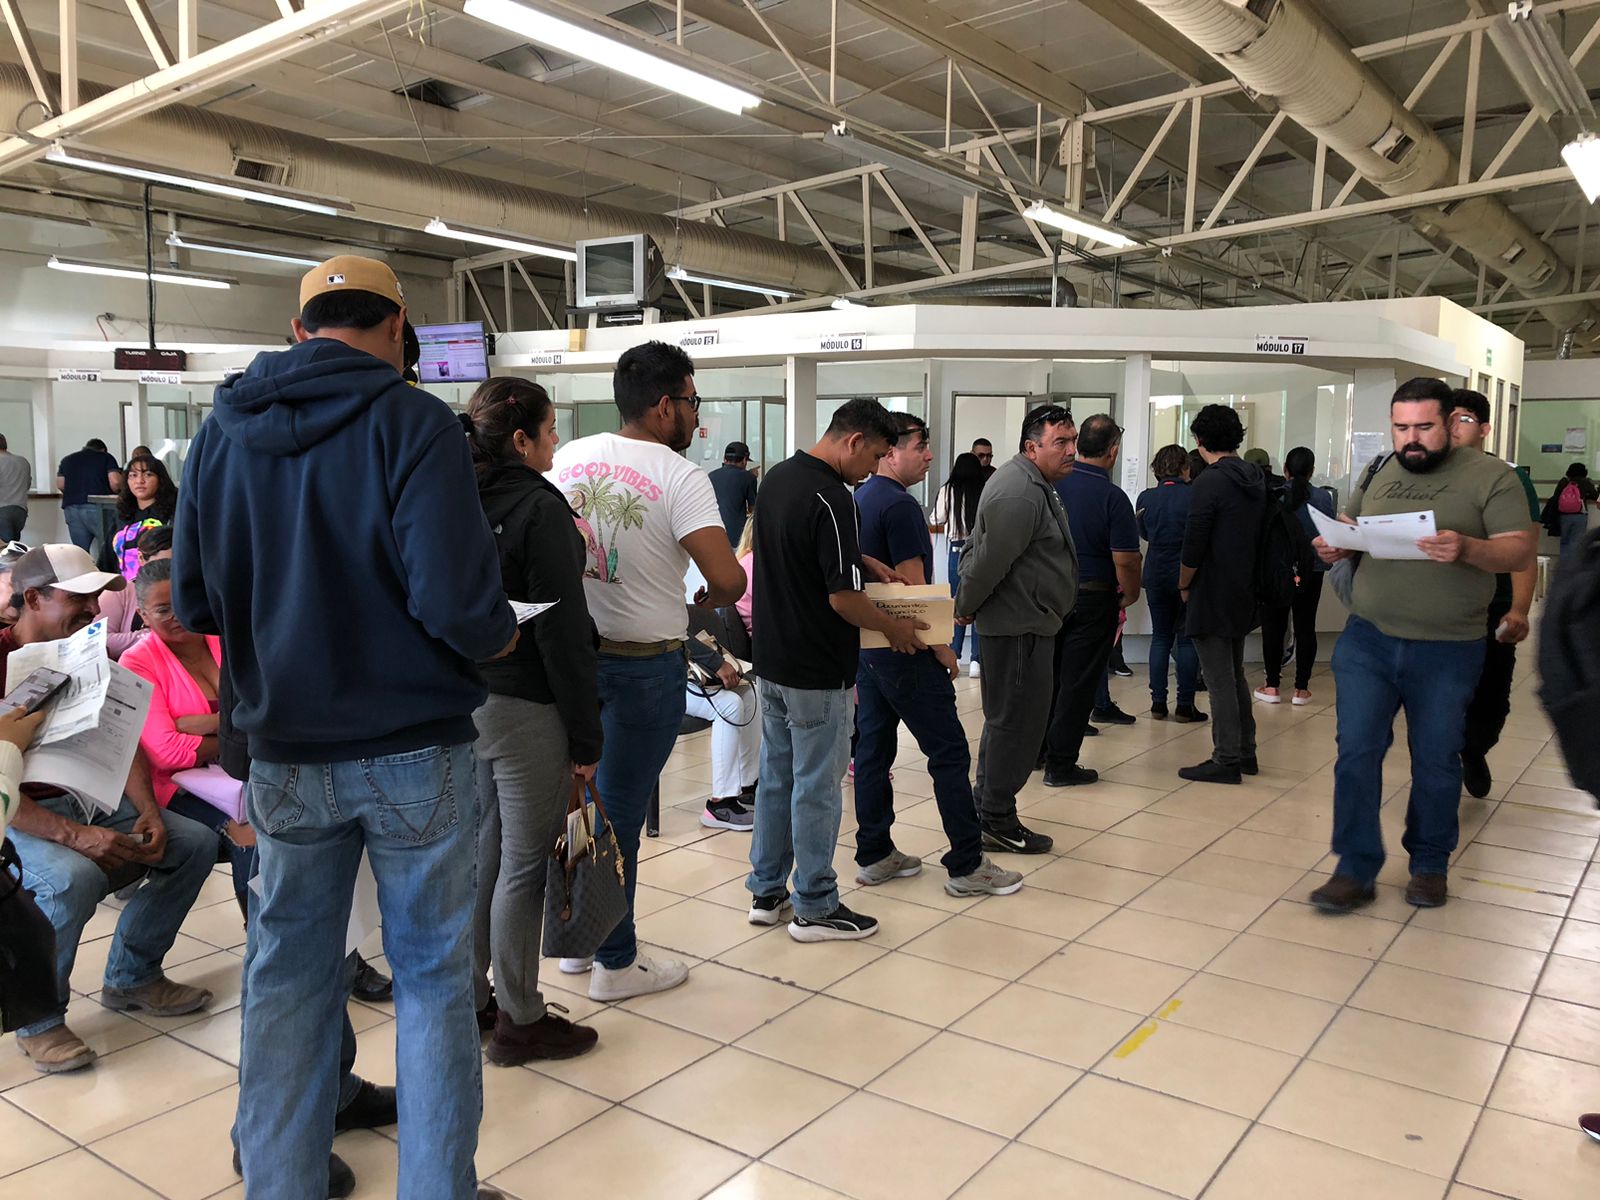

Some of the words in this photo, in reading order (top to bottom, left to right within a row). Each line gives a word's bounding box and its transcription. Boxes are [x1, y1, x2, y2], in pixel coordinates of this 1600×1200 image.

[820, 339, 849, 350] MÓDULO
[852, 339, 862, 349] 16
[1256, 341, 1290, 352] MÓDULO
[1293, 343, 1304, 354] 17
[531, 355, 552, 364] MÓDULO
[61, 373, 87, 381] MÓDULO
[558, 462, 611, 484] GOOD
[612, 464, 663, 502] VIBES
[1373, 480, 1450, 501] Patriot
